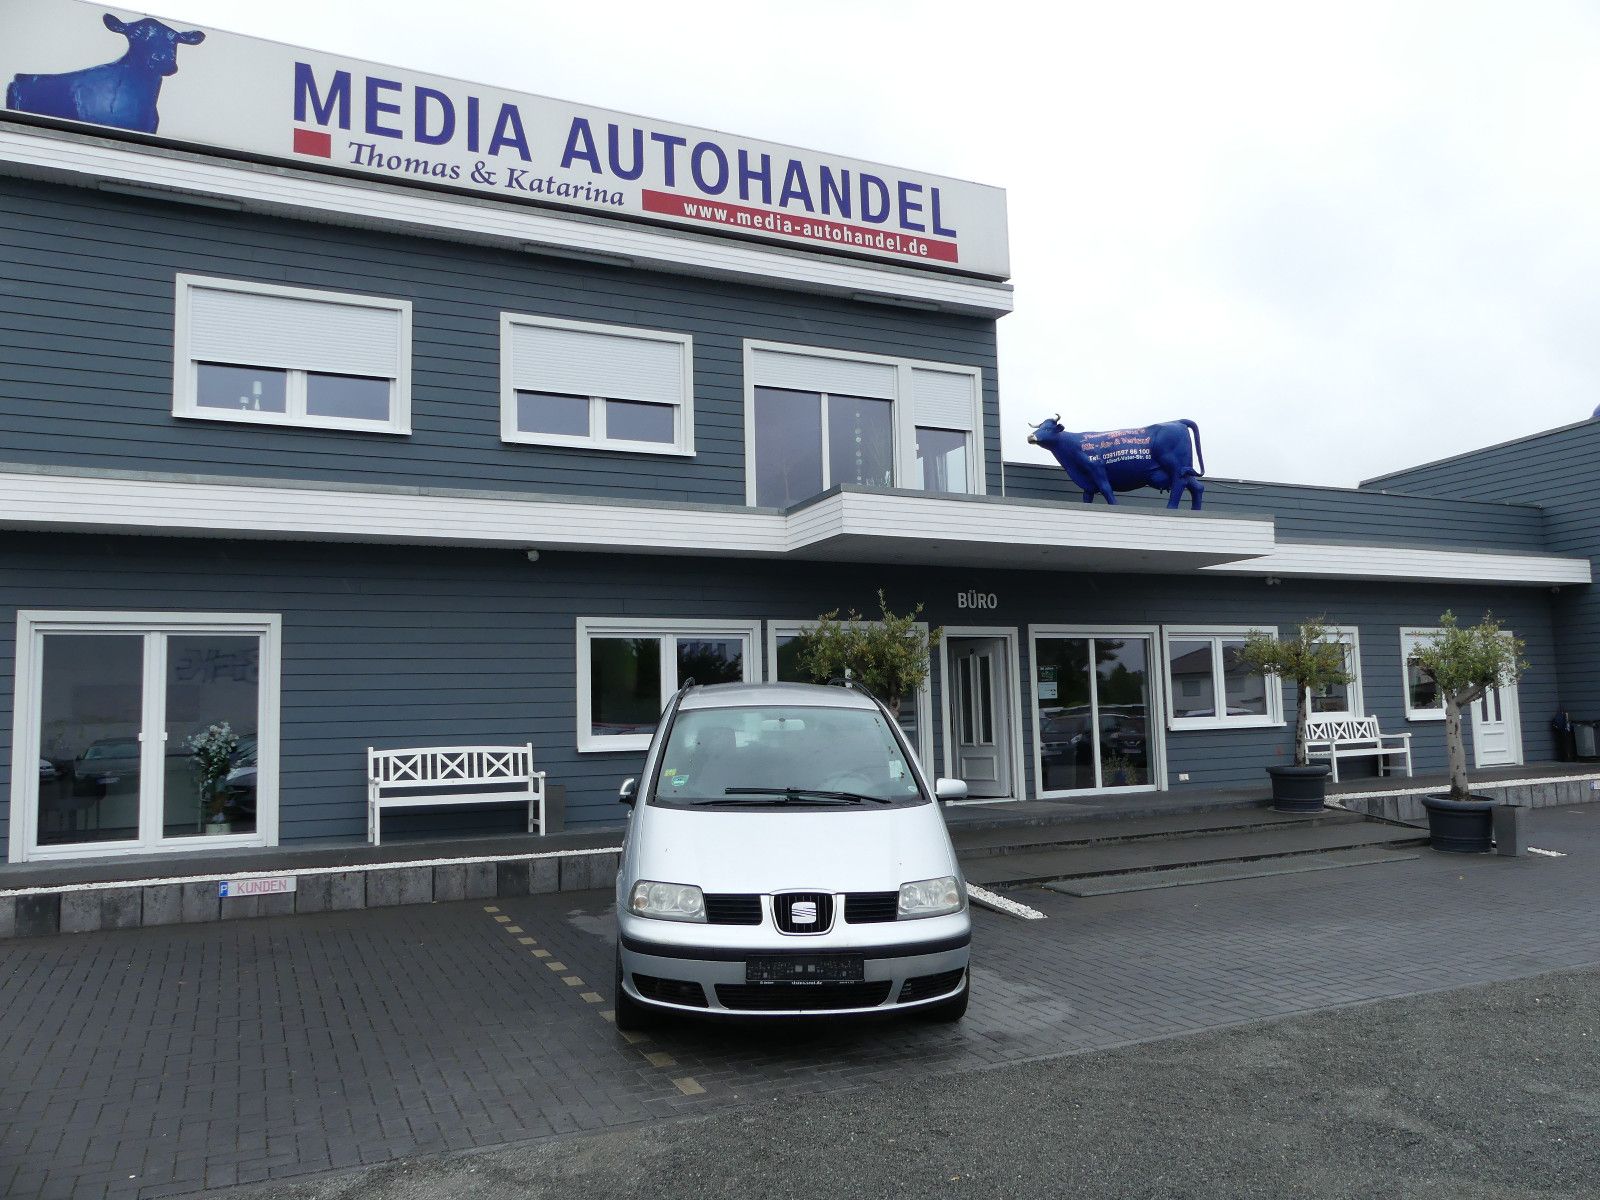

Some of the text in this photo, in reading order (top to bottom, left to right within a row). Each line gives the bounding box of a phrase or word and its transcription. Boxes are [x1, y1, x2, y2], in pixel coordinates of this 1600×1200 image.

[293, 61, 957, 239] MEDIA AUTOHANDEL
[348, 141, 625, 207] Thomas & Katarina
[684, 203, 928, 257] www.media-autohandel.de
[957, 589, 998, 609] BÜRO
[237, 880, 287, 894] KUNDEN
